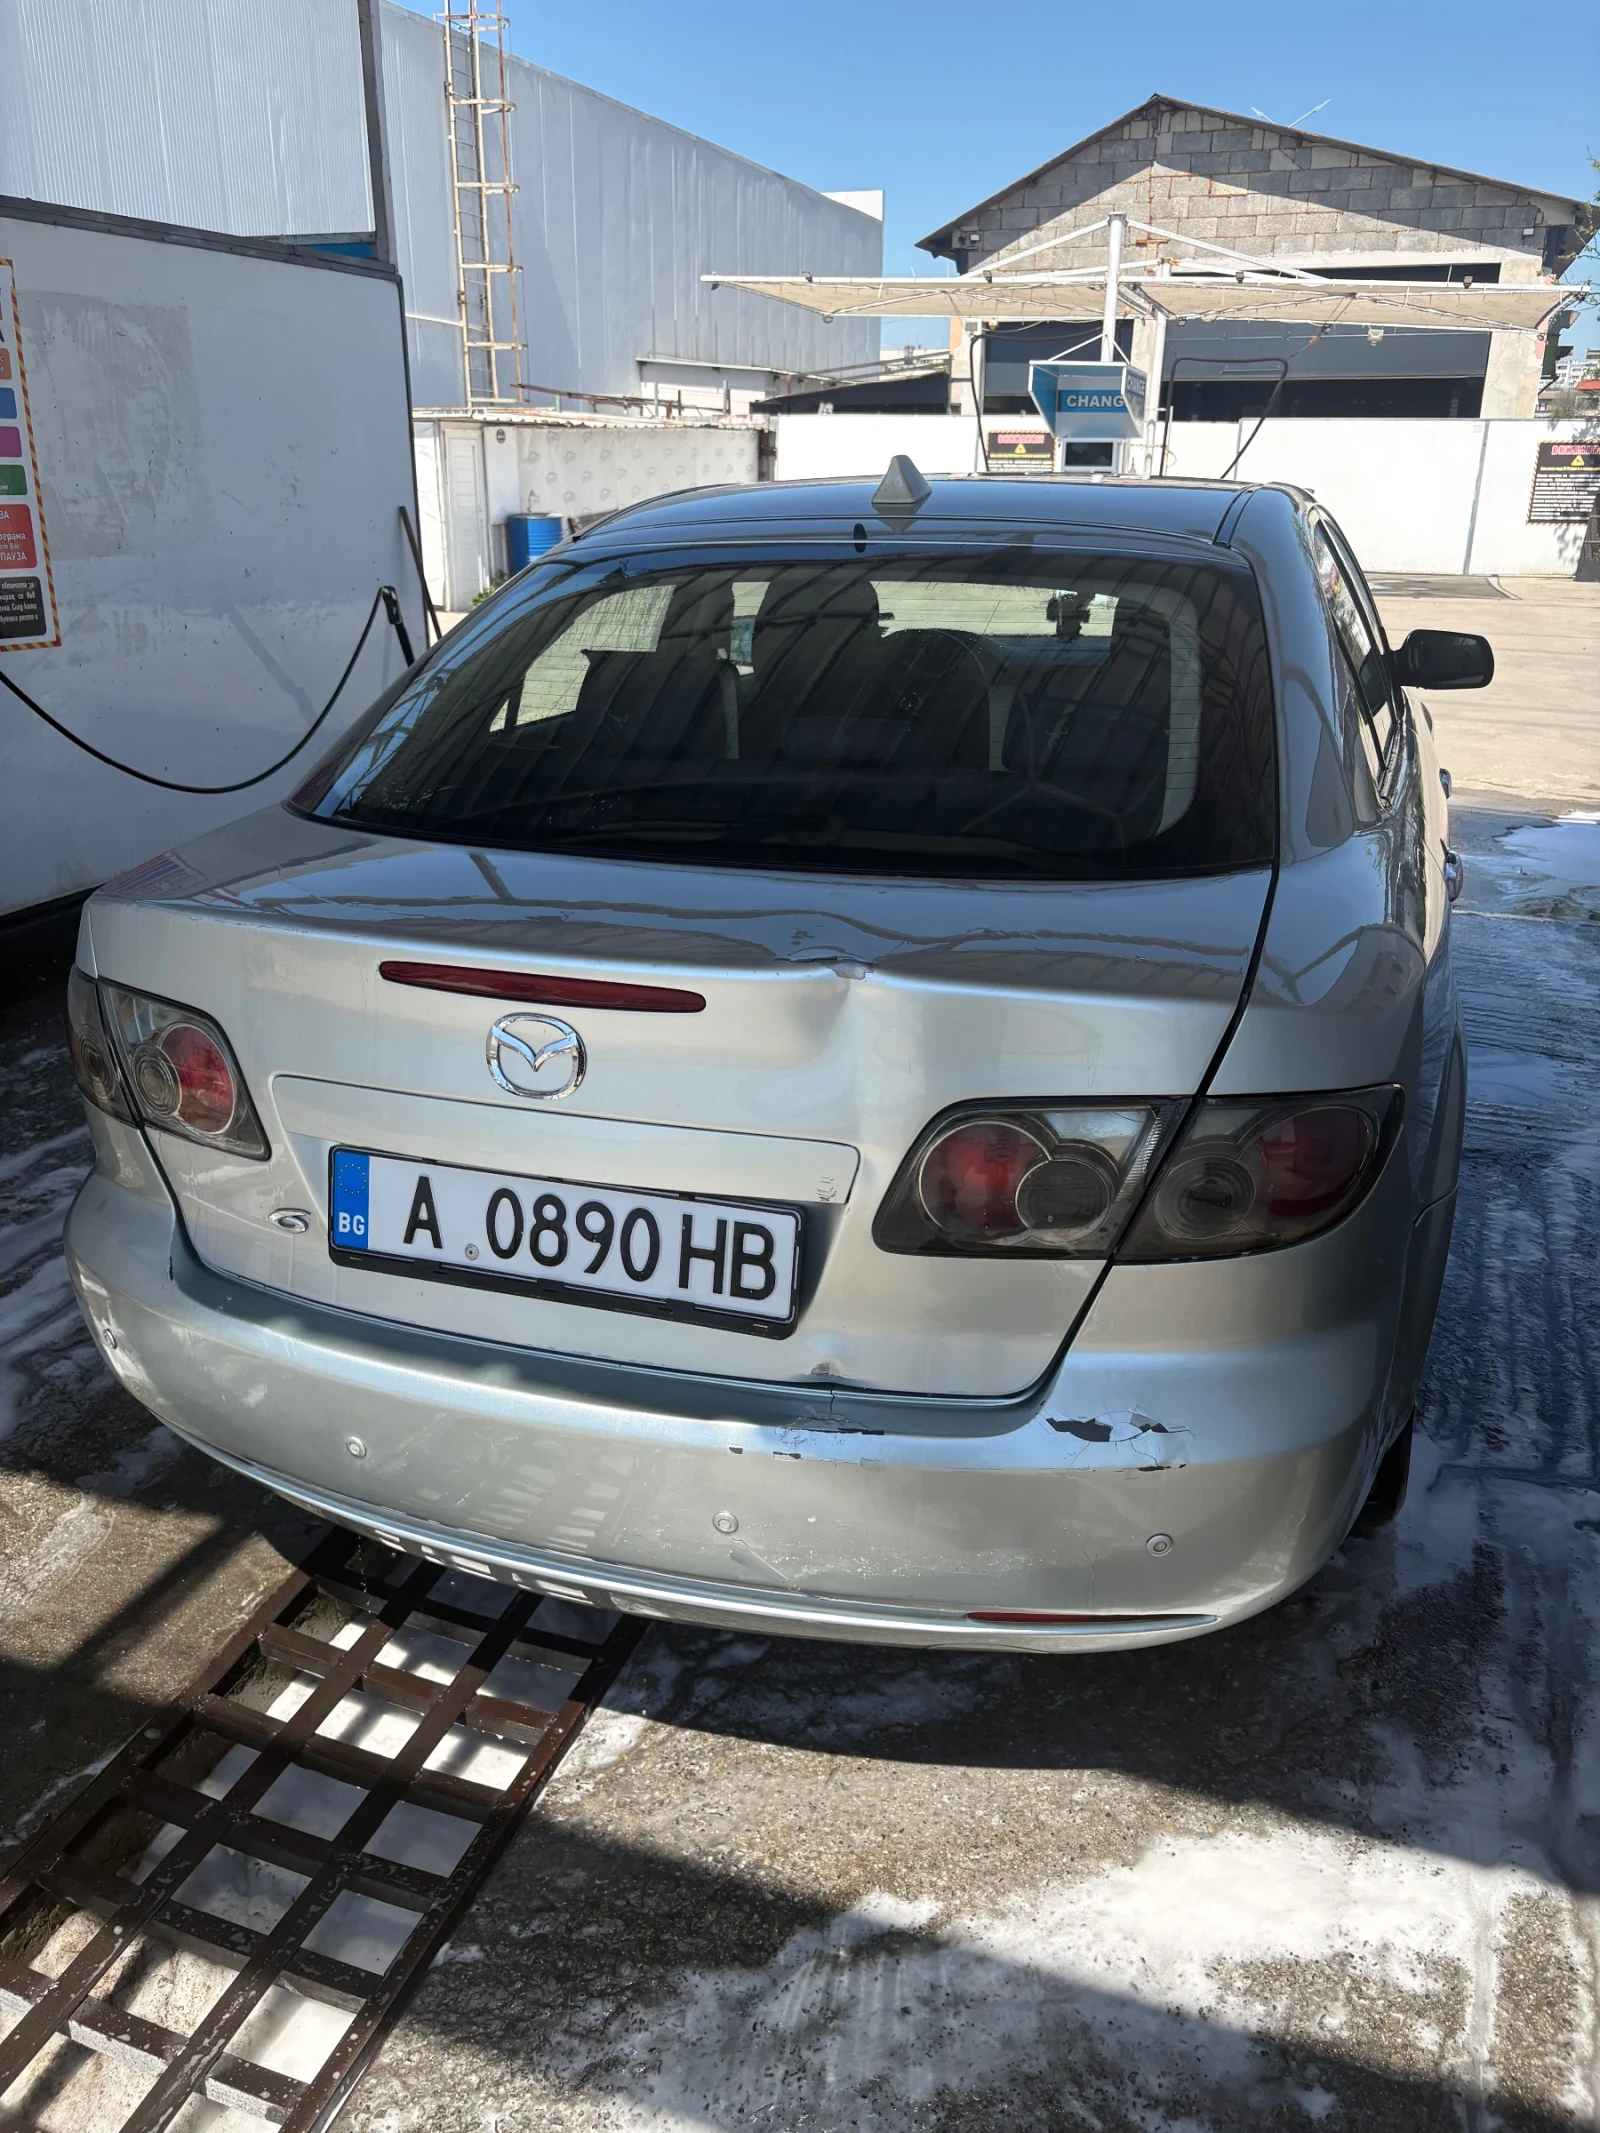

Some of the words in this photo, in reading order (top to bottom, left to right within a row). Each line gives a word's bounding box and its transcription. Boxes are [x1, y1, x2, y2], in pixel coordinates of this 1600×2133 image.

[1126, 374, 1146, 397] CHANGE
[1066, 394, 1126, 408] CHANG
[338, 1211, 366, 1236] BG
[403, 1175, 443, 1249] A
[485, 1187, 663, 1282] 0890
[678, 1213, 776, 1300] HB
